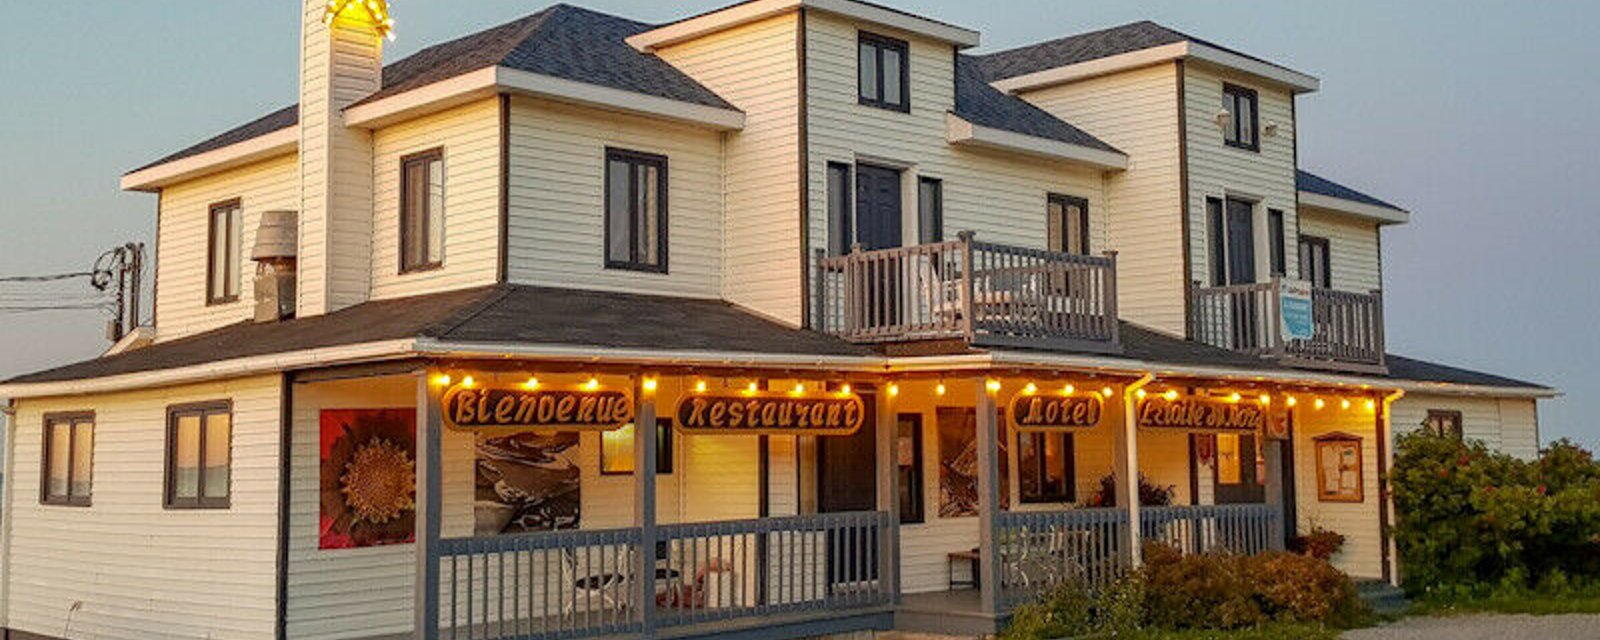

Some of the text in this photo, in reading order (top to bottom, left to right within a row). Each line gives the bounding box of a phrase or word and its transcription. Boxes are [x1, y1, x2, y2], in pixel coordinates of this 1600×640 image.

[455, 389, 630, 423] Bienvenue
[687, 398, 857, 427] Restaurant
[1022, 397, 1097, 424] Motel
